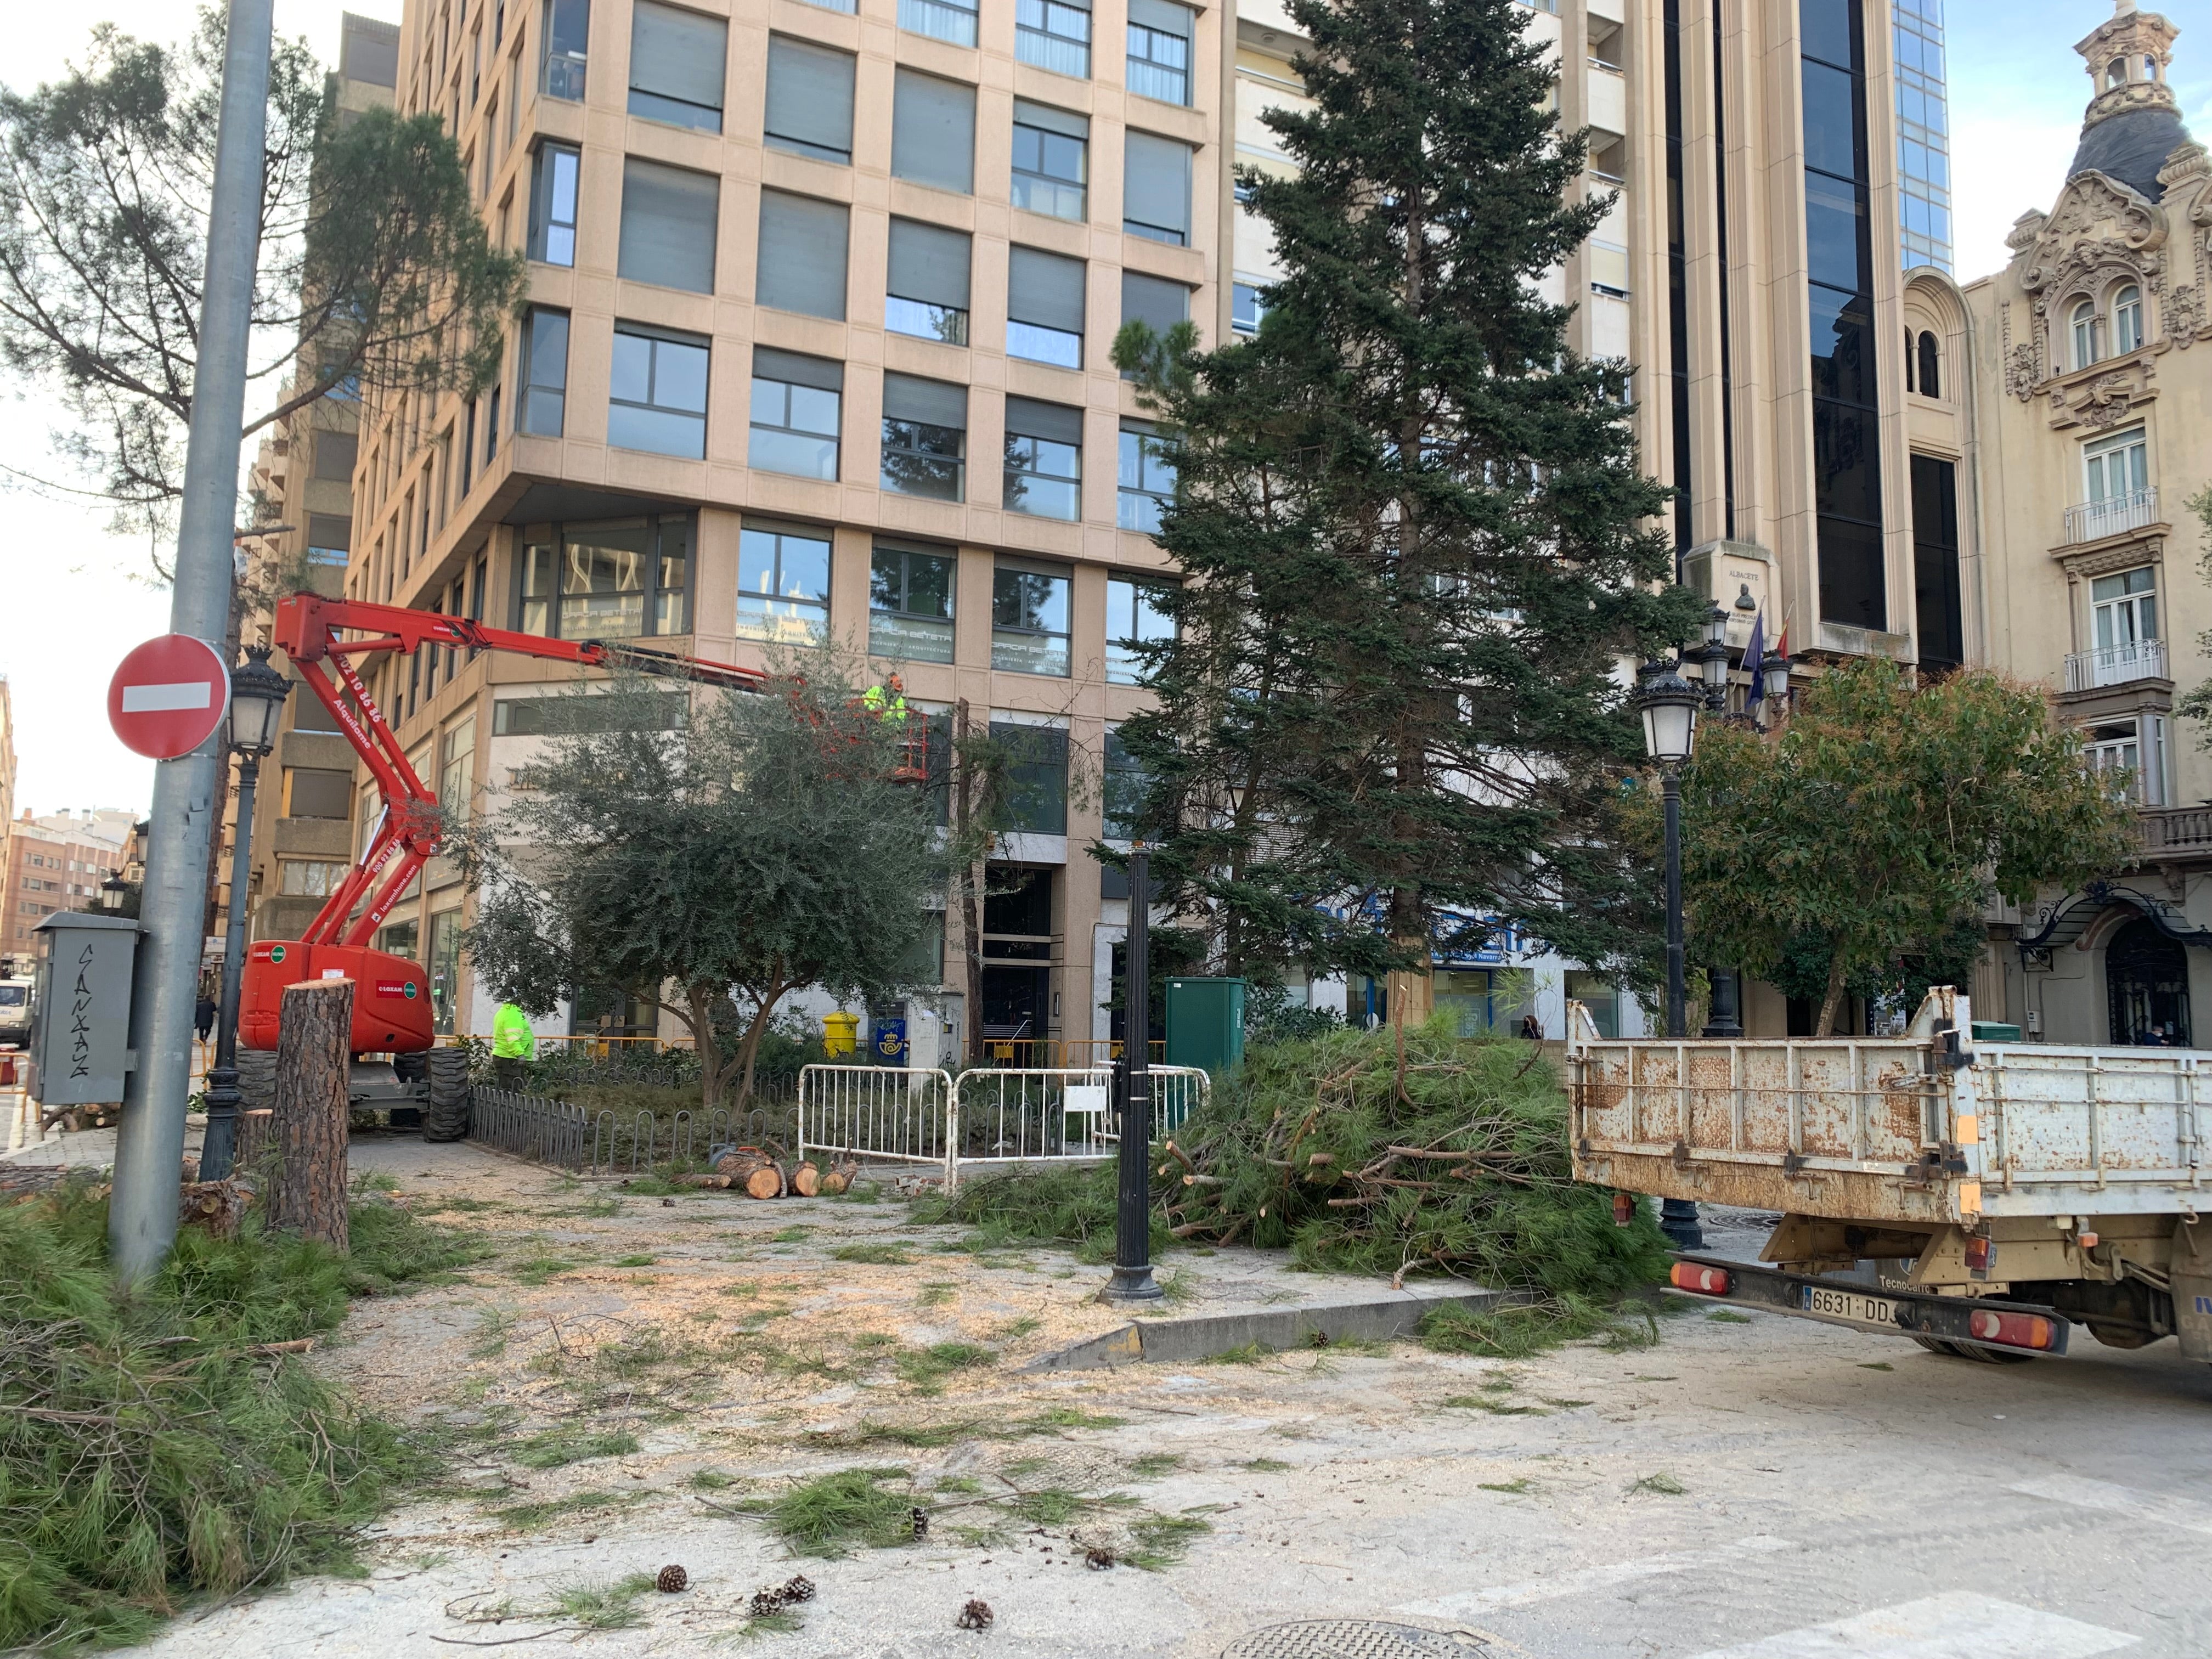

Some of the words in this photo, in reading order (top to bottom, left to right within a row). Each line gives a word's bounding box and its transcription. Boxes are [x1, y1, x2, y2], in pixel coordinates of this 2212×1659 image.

[1729, 571, 1758, 581] ALBACETE
[908, 644, 951, 654] ARQUITECTURA
[910, 630, 952, 642] BETETA
[337, 654, 353, 675] 902
[351, 676, 363, 690] 10
[359, 691, 373, 707] 86
[369, 707, 382, 723] 86
[373, 862, 382, 873] 900
[381, 854, 389, 863] 92
[387, 846, 395, 855] 86
[393, 839, 400, 847] 86
[380, 865, 416, 912] loxamhune.com
[1879, 1274, 1930, 1294] Tecnocarro
[1813, 1291, 1851, 1316] 6631
[1865, 1299, 1898, 1324] DD
